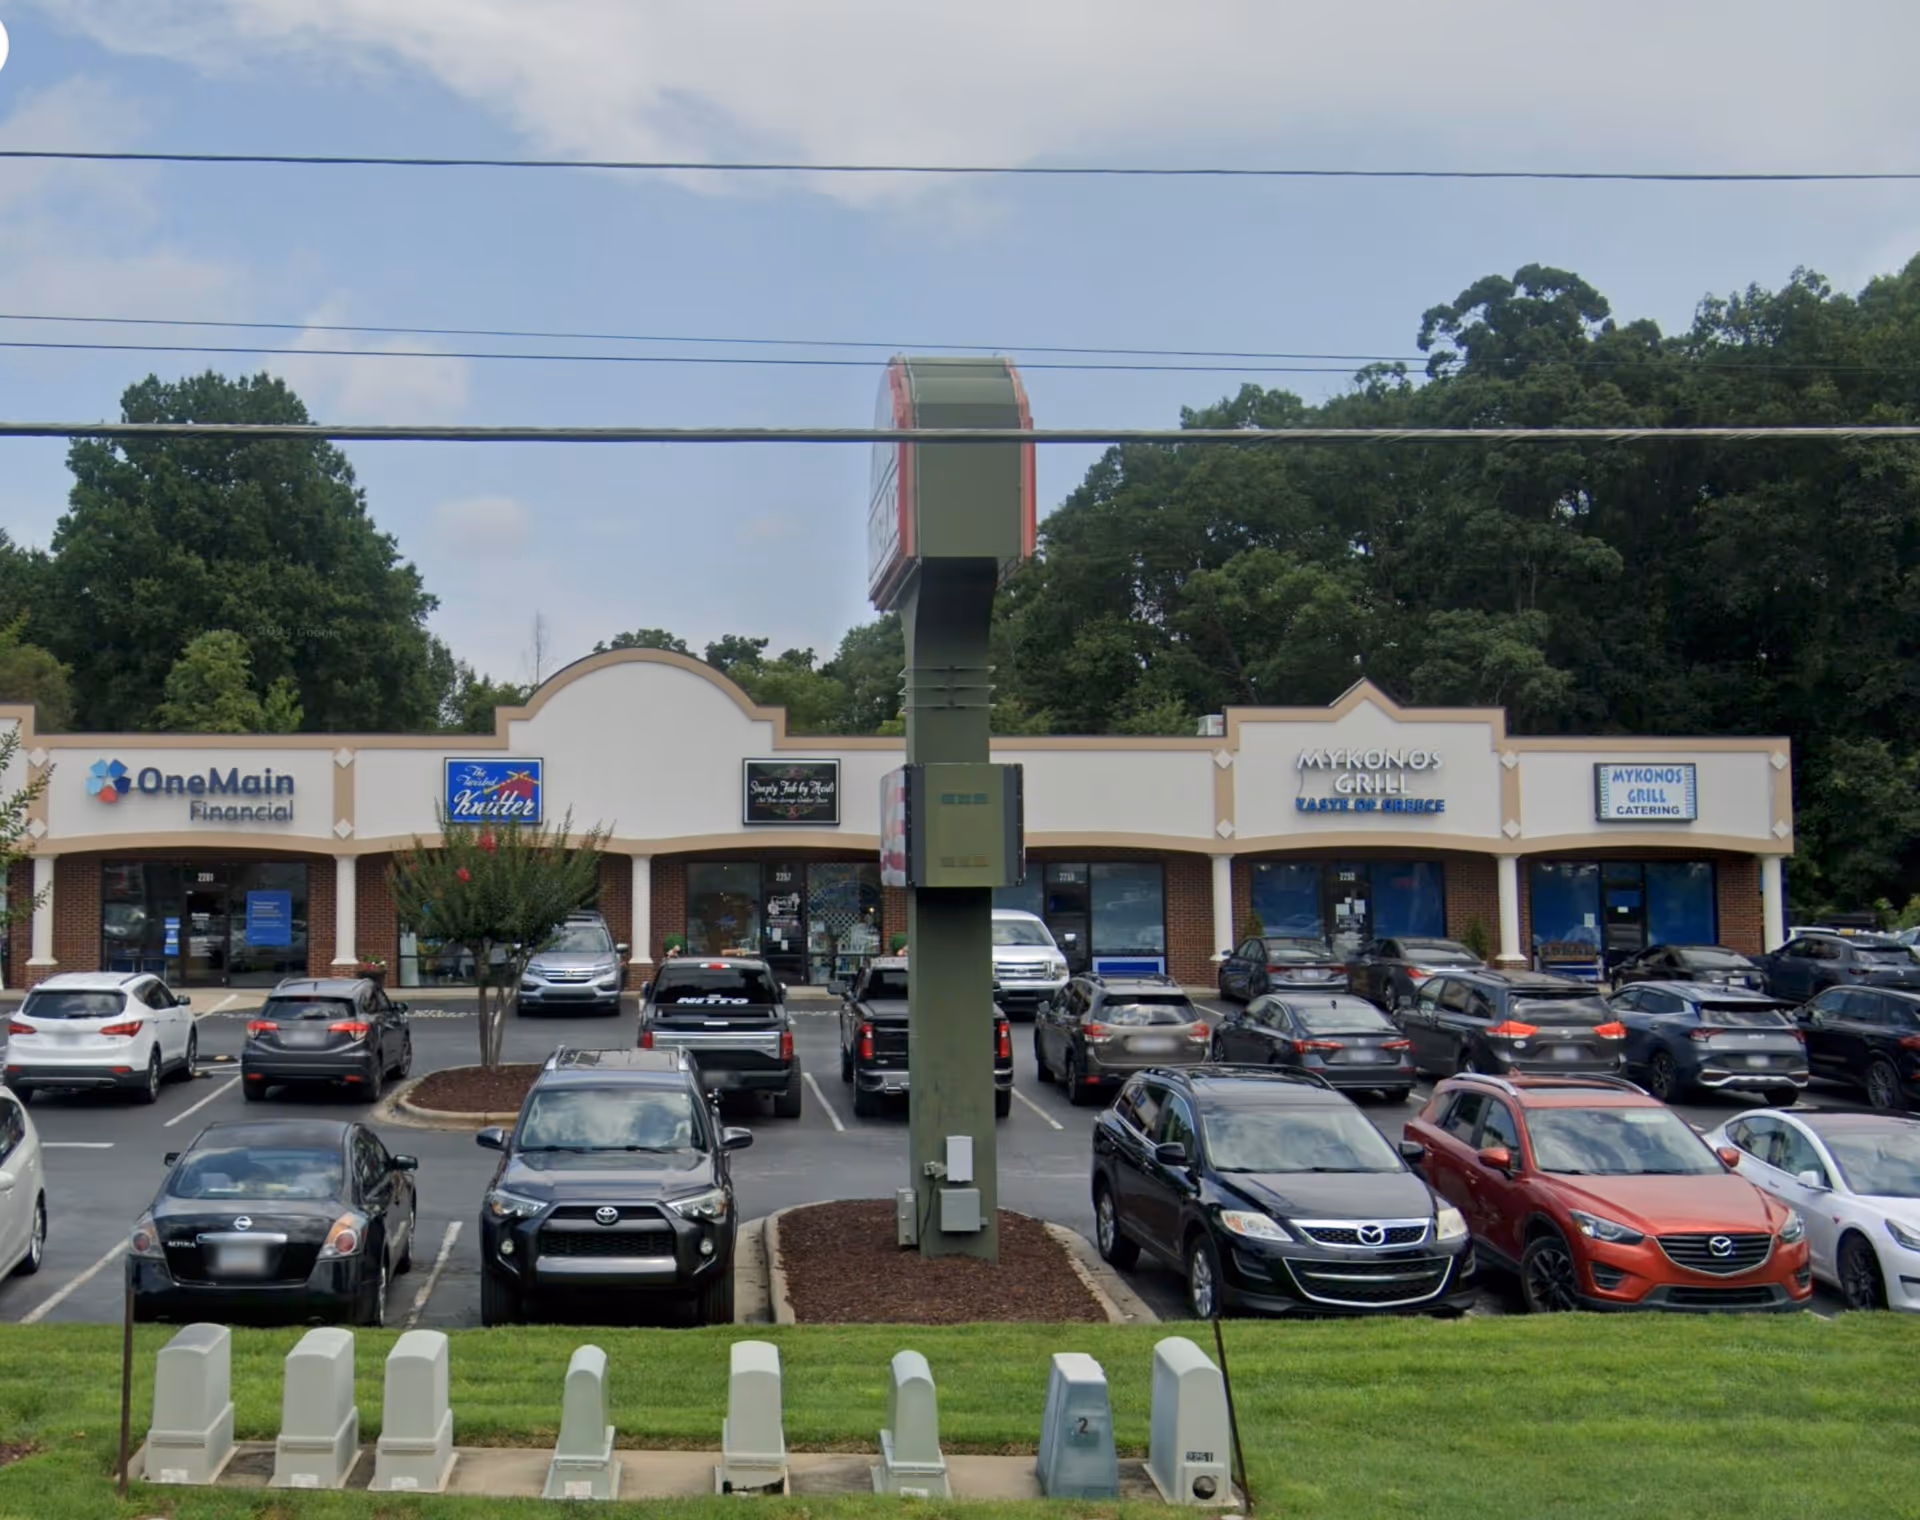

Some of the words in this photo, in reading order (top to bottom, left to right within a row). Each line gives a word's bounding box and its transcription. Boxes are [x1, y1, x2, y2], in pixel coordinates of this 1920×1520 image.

[1297, 749, 1442, 769] MYKONOS
[465, 765, 487, 777] The
[1612, 768, 1683, 784] MYKONOS
[138, 767, 294, 794] OneMain
[799, 782, 808, 796] by
[1334, 773, 1411, 794] GRILL
[453, 789, 535, 816] Knitter
[1627, 788, 1667, 804] GRILL
[190, 800, 294, 821] Financial
[1296, 797, 1349, 813] TASTE
[1354, 798, 1378, 813] OF
[1381, 798, 1446, 814] GREECE
[1616, 805, 1680, 816] CATERING
[676, 997, 749, 1005] NITTO
[1077, 1417, 1088, 1434] 2
